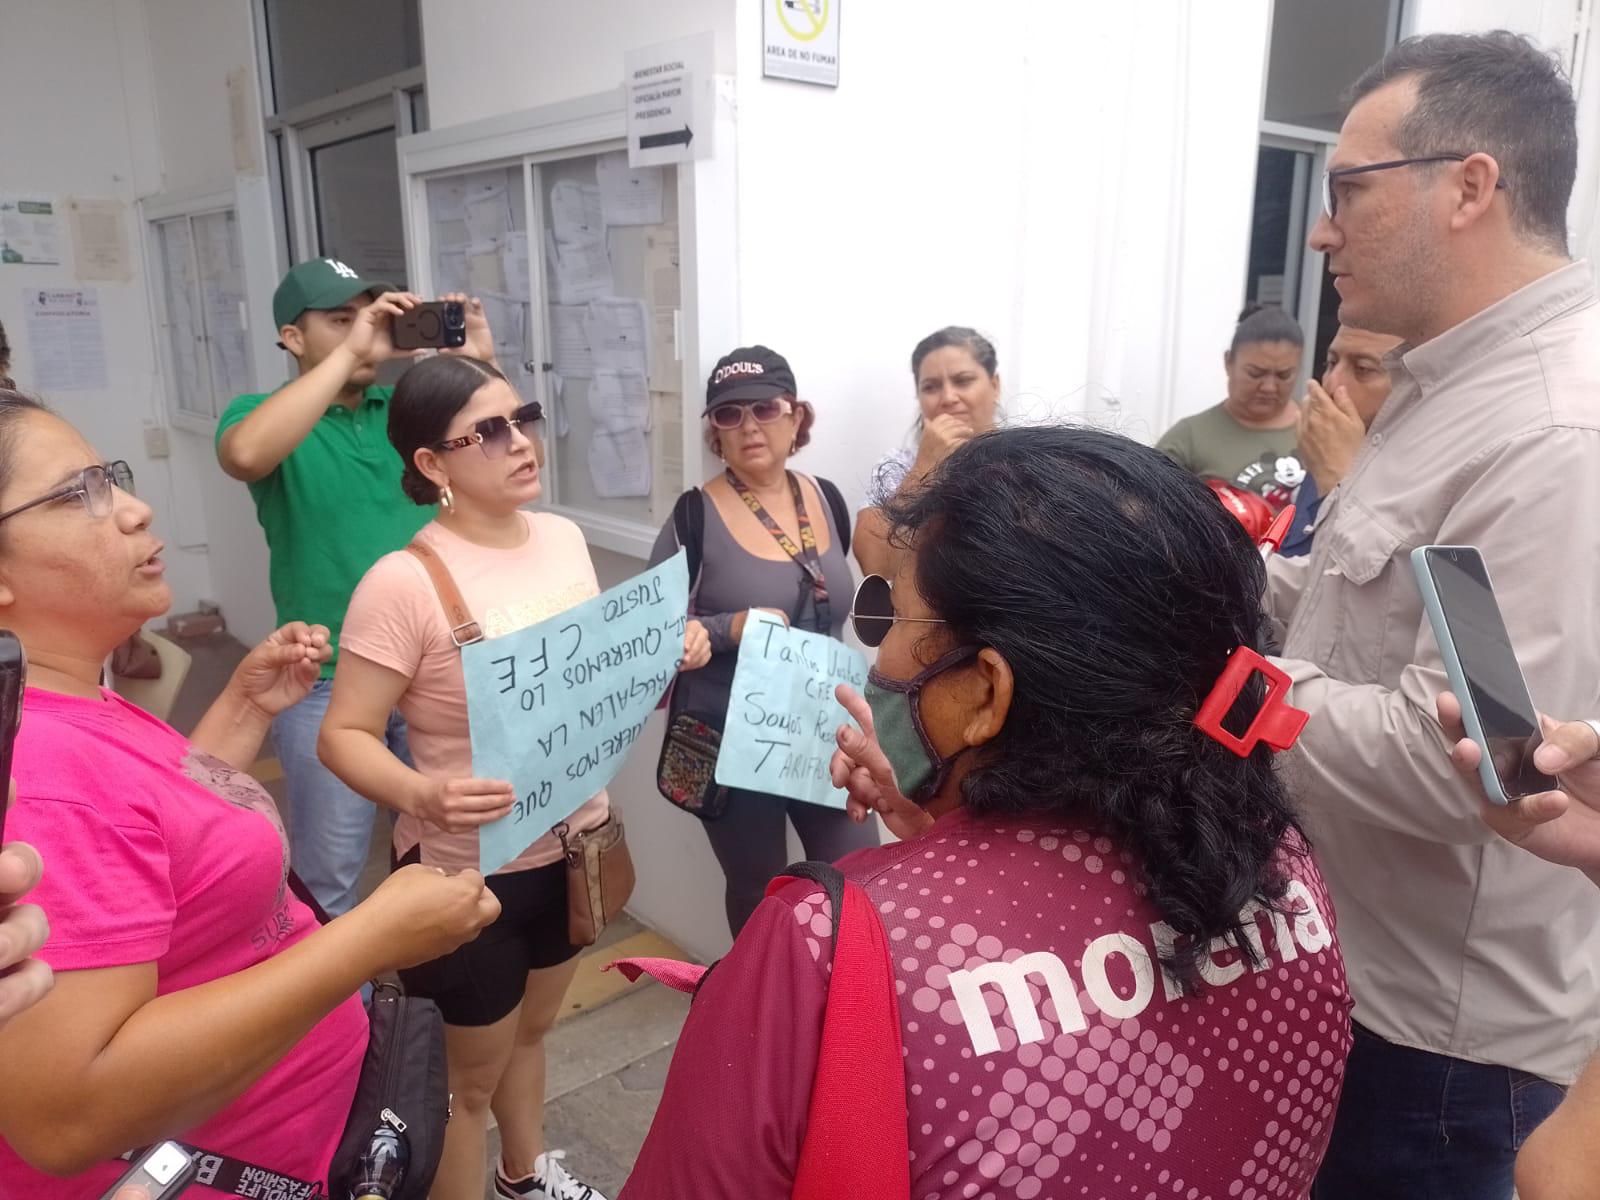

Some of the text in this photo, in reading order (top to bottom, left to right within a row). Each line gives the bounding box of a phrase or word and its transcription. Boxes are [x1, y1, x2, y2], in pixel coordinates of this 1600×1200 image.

[767, 45, 836, 65] AREA DE NO FUMAR
[324, 258, 359, 279] LA
[562, 627, 661, 690] QUEREMOS
[520, 683, 545, 711] LO
[537, 723, 568, 758] LA
[513, 716, 649, 825] UEREMOS QUE
[946, 879, 1333, 1058] morena
[240, 1166, 311, 1198] FASHION
